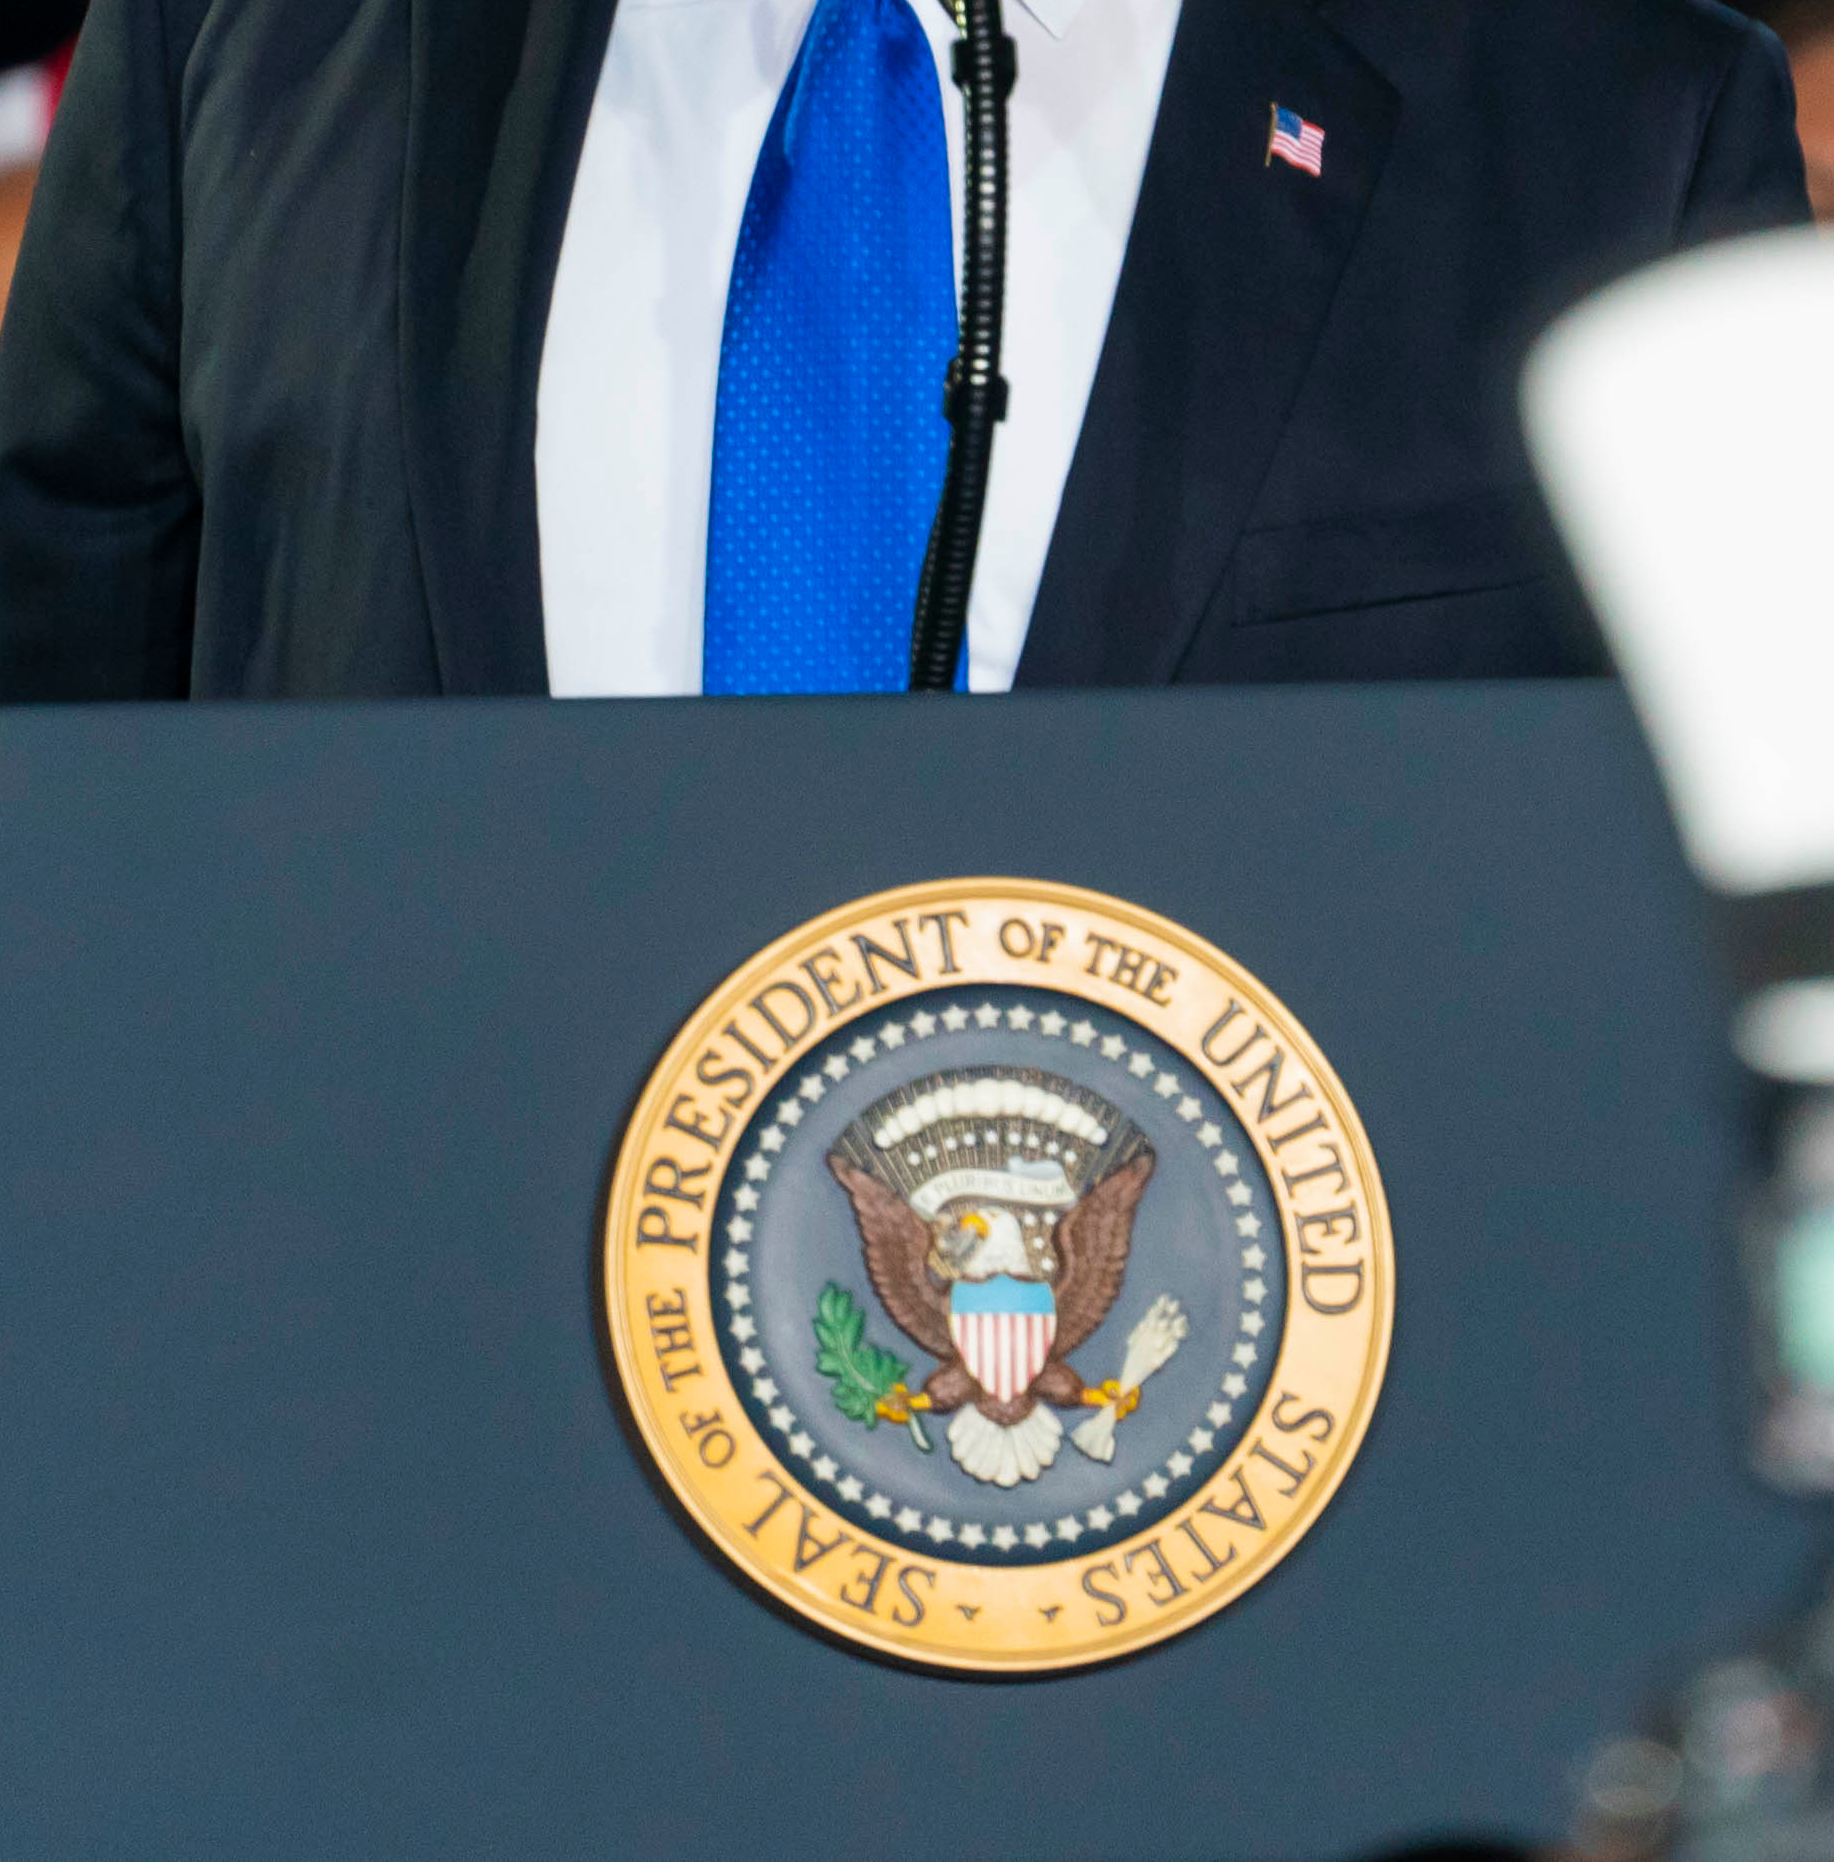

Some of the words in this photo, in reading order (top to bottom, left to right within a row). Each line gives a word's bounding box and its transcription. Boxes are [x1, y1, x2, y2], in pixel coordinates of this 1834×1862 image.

[998, 917, 1066, 966] OF
[1084, 933, 1180, 1008] THE
[637, 910, 969, 1255] PRESIDENT
[1201, 998, 1365, 1318] UNITED
[646, 1286, 705, 1391] THE
[679, 1403, 736, 1471] OF
[745, 1469, 937, 1629] SEAL
[1082, 1390, 1336, 1629] STATES
